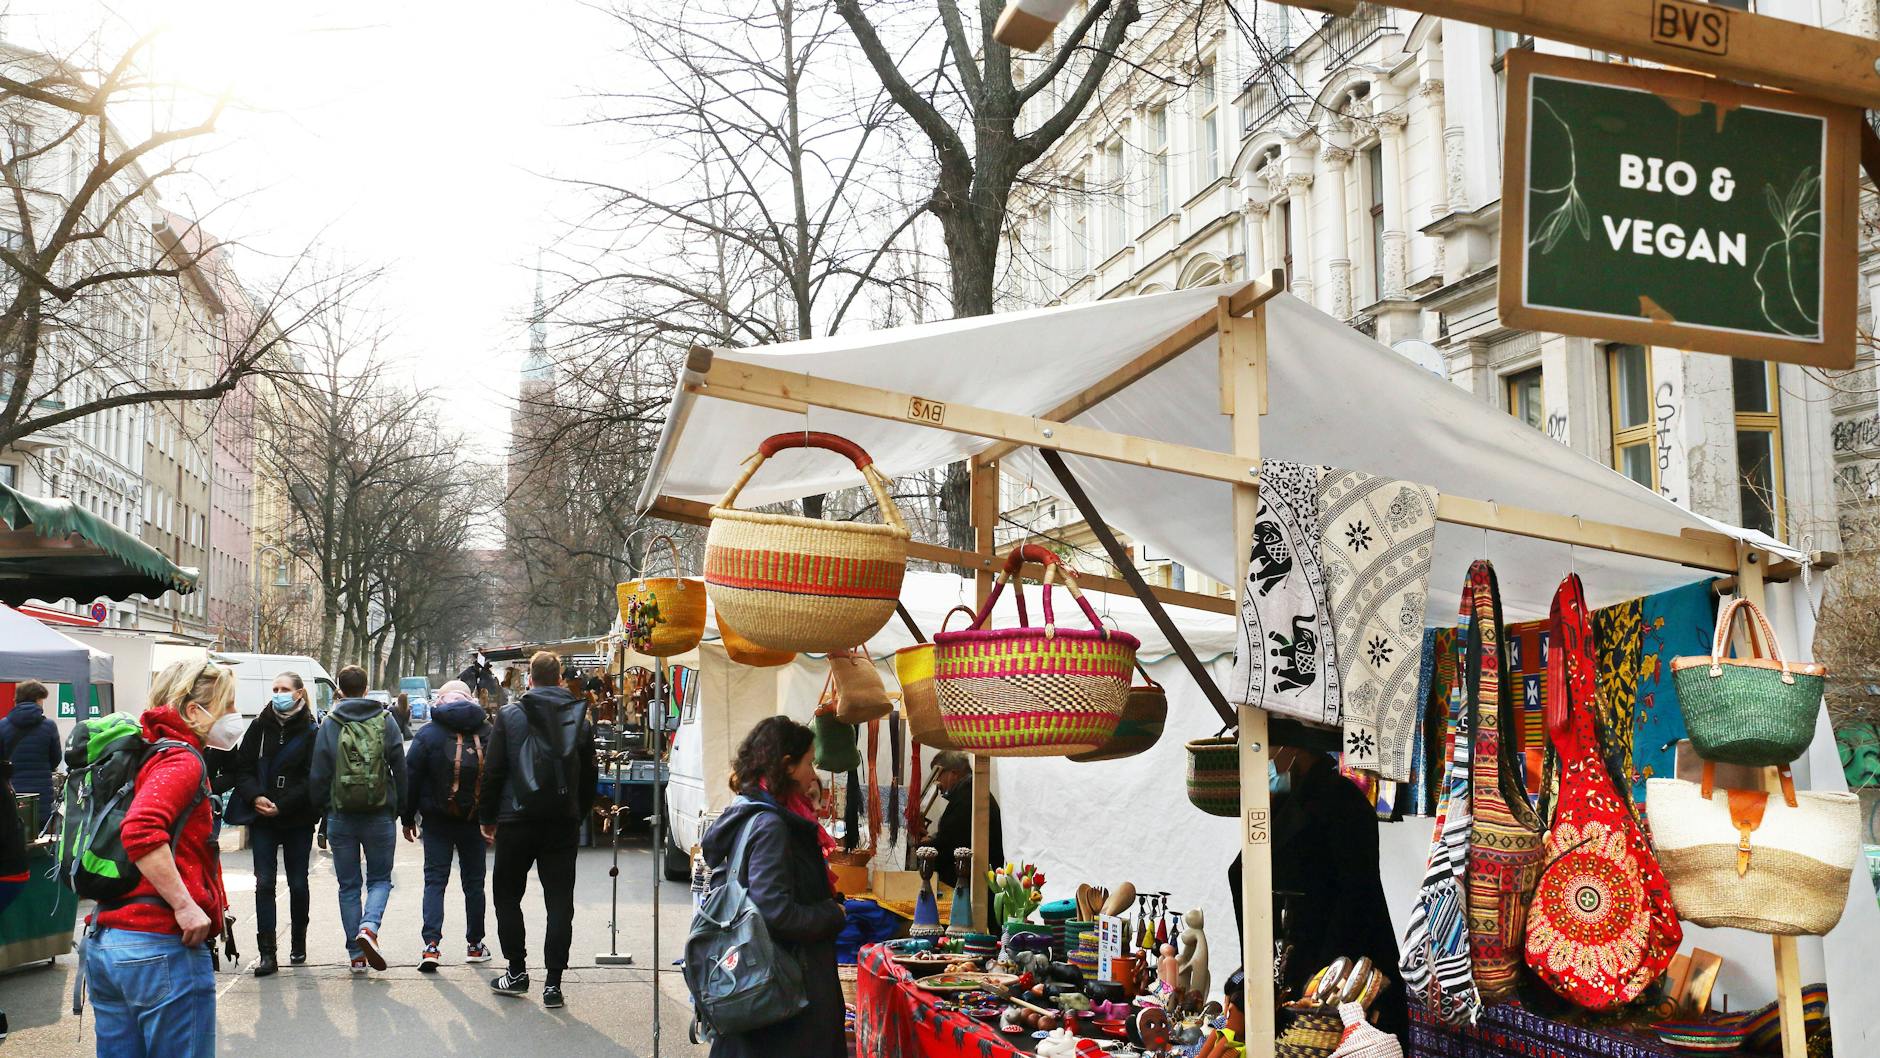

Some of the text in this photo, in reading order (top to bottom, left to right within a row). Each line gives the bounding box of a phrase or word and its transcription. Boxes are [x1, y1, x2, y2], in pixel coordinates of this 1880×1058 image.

[1659, 4, 1722, 46] BVS
[1619, 153, 1735, 202] BIO &
[1602, 215, 1746, 267] VEGAN
[912, 401, 942, 421] BVS
[1251, 811, 1266, 841] BVS
